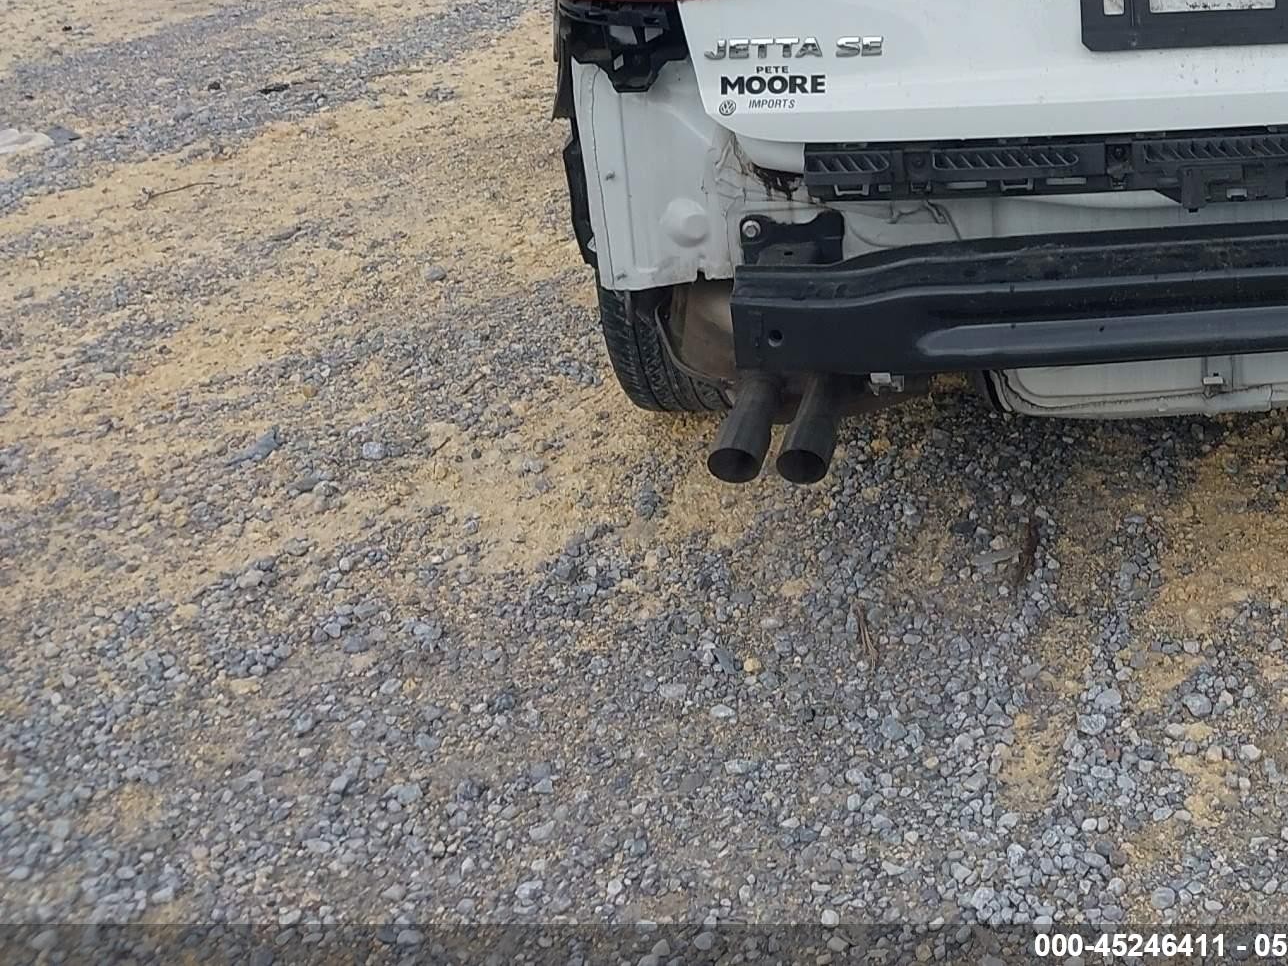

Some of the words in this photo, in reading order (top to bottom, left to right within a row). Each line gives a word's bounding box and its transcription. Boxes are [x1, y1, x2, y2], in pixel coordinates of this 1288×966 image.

[704, 36, 823, 60] JETTA
[835, 35, 884, 58] SE
[756, 65, 789, 74] PETE
[720, 74, 826, 95] MOORE
[748, 99, 795, 109] IMPORTS
